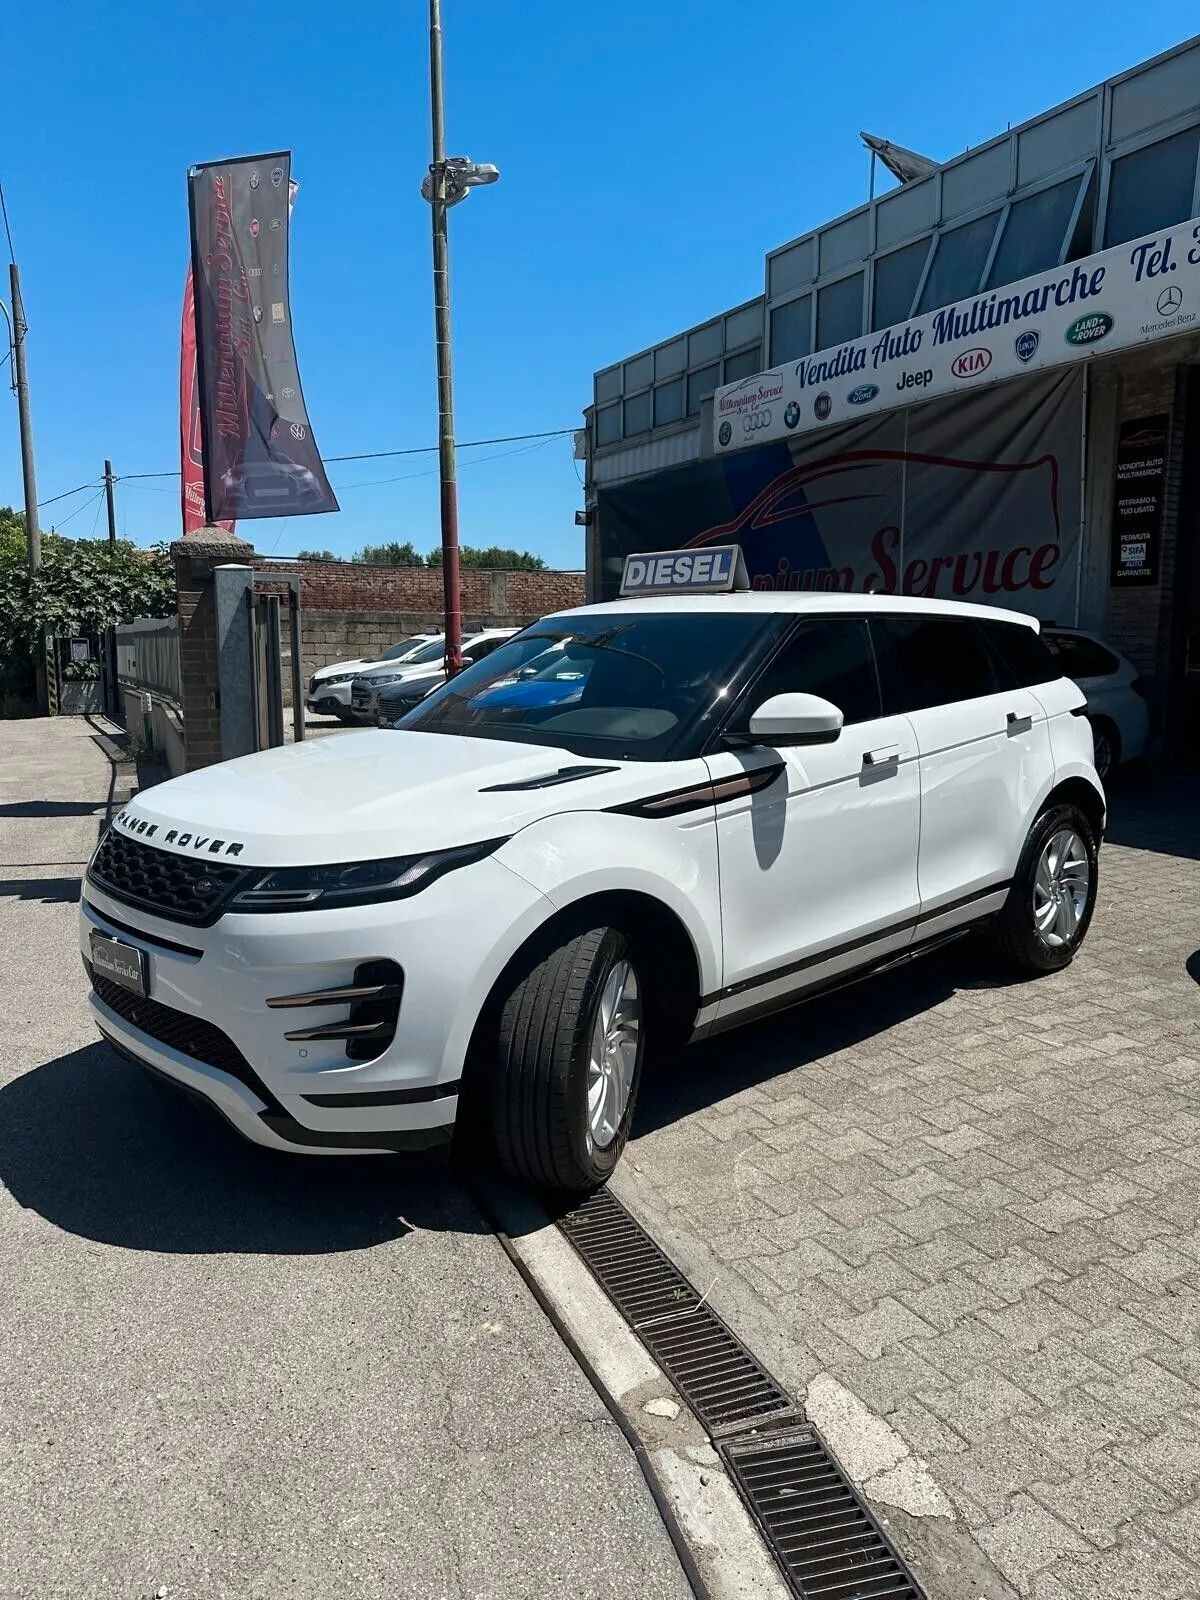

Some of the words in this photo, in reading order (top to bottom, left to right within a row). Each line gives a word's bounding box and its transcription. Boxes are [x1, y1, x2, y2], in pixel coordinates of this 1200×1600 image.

[206, 175, 232, 273] Service
[796, 346, 867, 389] Vendita
[872, 326, 924, 370] Auto
[932, 265, 1106, 346] Multimarche
[1130, 237, 1177, 282] Tel.
[958, 351, 985, 374] KIA
[896, 368, 933, 391] Jeep
[758, 385, 784, 400] Service
[852, 387, 874, 402] Ford
[1117, 467, 1163, 480] MULTIMARCHE
[1118, 460, 1145, 471] VENDITA
[1146, 458, 1163, 467] AUTO
[1120, 507, 1133, 515] TUO
[1134, 505, 1155, 514] USATO
[1120, 532, 1151, 541] PERMUTA
[625, 553, 729, 587] DIESEL
[864, 526, 1061, 599] Service
[1117, 568, 1151, 577] GARANTITE
[117, 811, 159, 838] RANGE
[164, 829, 245, 857] ROVER
